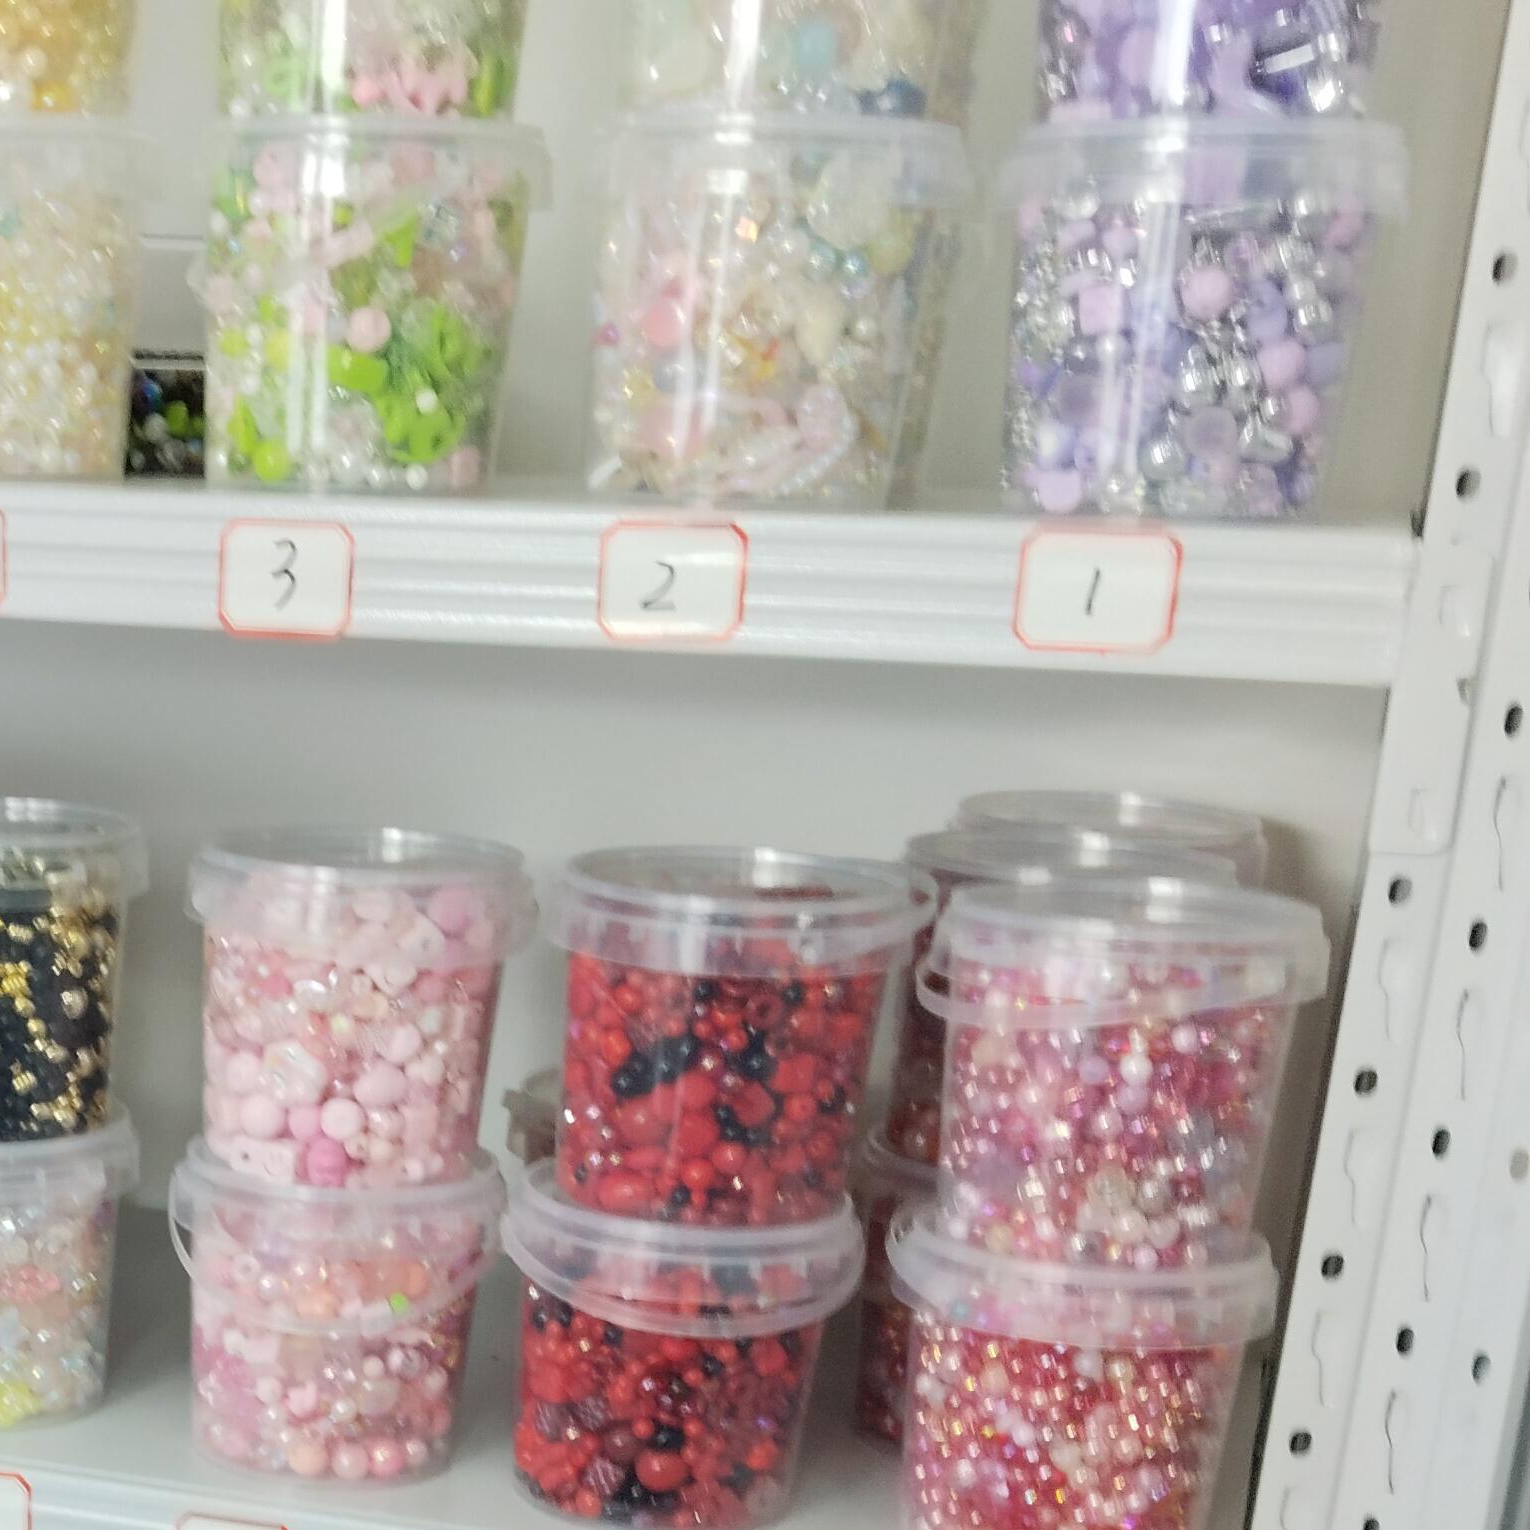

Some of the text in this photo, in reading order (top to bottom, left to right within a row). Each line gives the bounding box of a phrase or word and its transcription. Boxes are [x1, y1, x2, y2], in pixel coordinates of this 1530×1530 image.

[271, 537, 298, 610] 3
[640, 561, 675, 611] 2
[1085, 567, 1102, 615] 1
